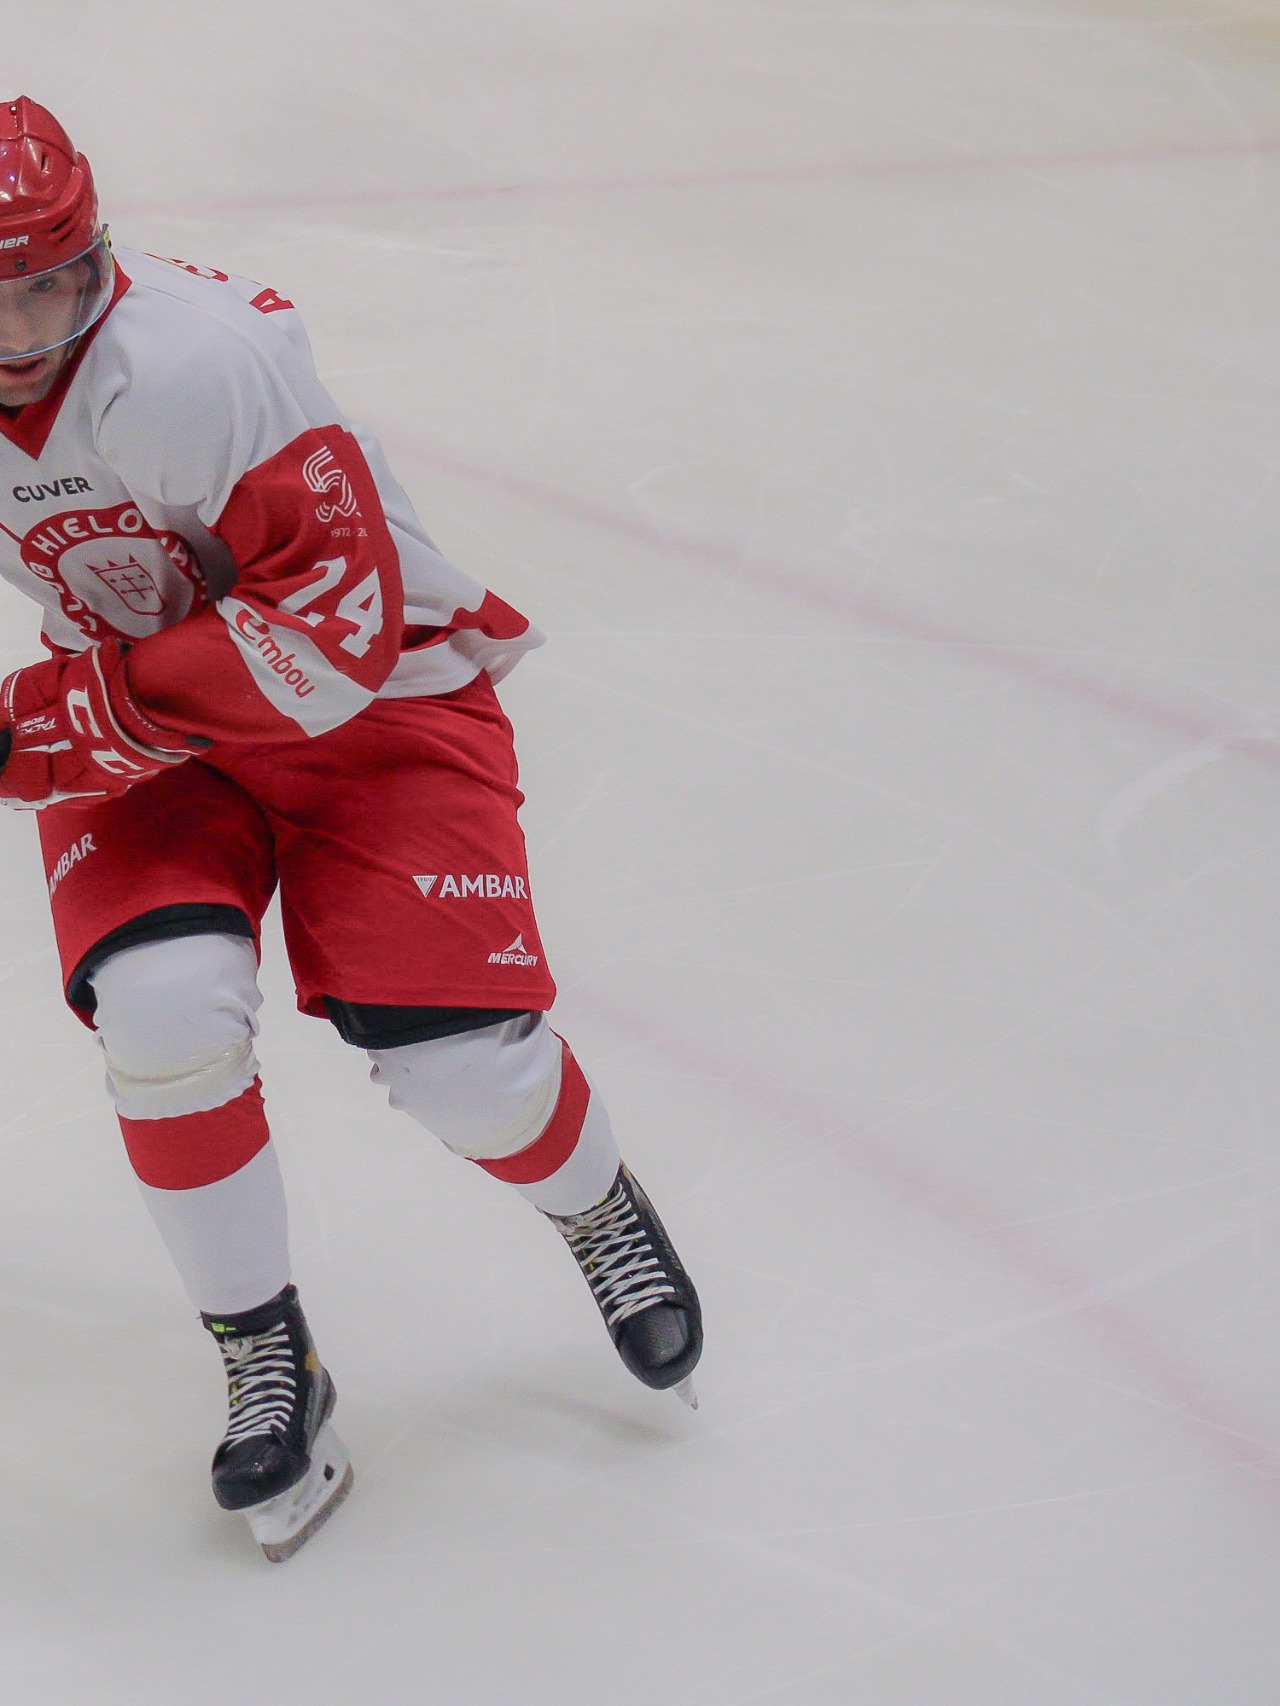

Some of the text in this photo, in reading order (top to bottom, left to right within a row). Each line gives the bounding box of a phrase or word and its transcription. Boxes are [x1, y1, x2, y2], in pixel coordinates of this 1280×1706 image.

[12, 476, 95, 503] CUVER
[31, 508, 144, 556] HIELO
[277, 555, 384, 659] 24
[438, 874, 529, 900] AMBAR
[487, 952, 539, 967] MERCURY
